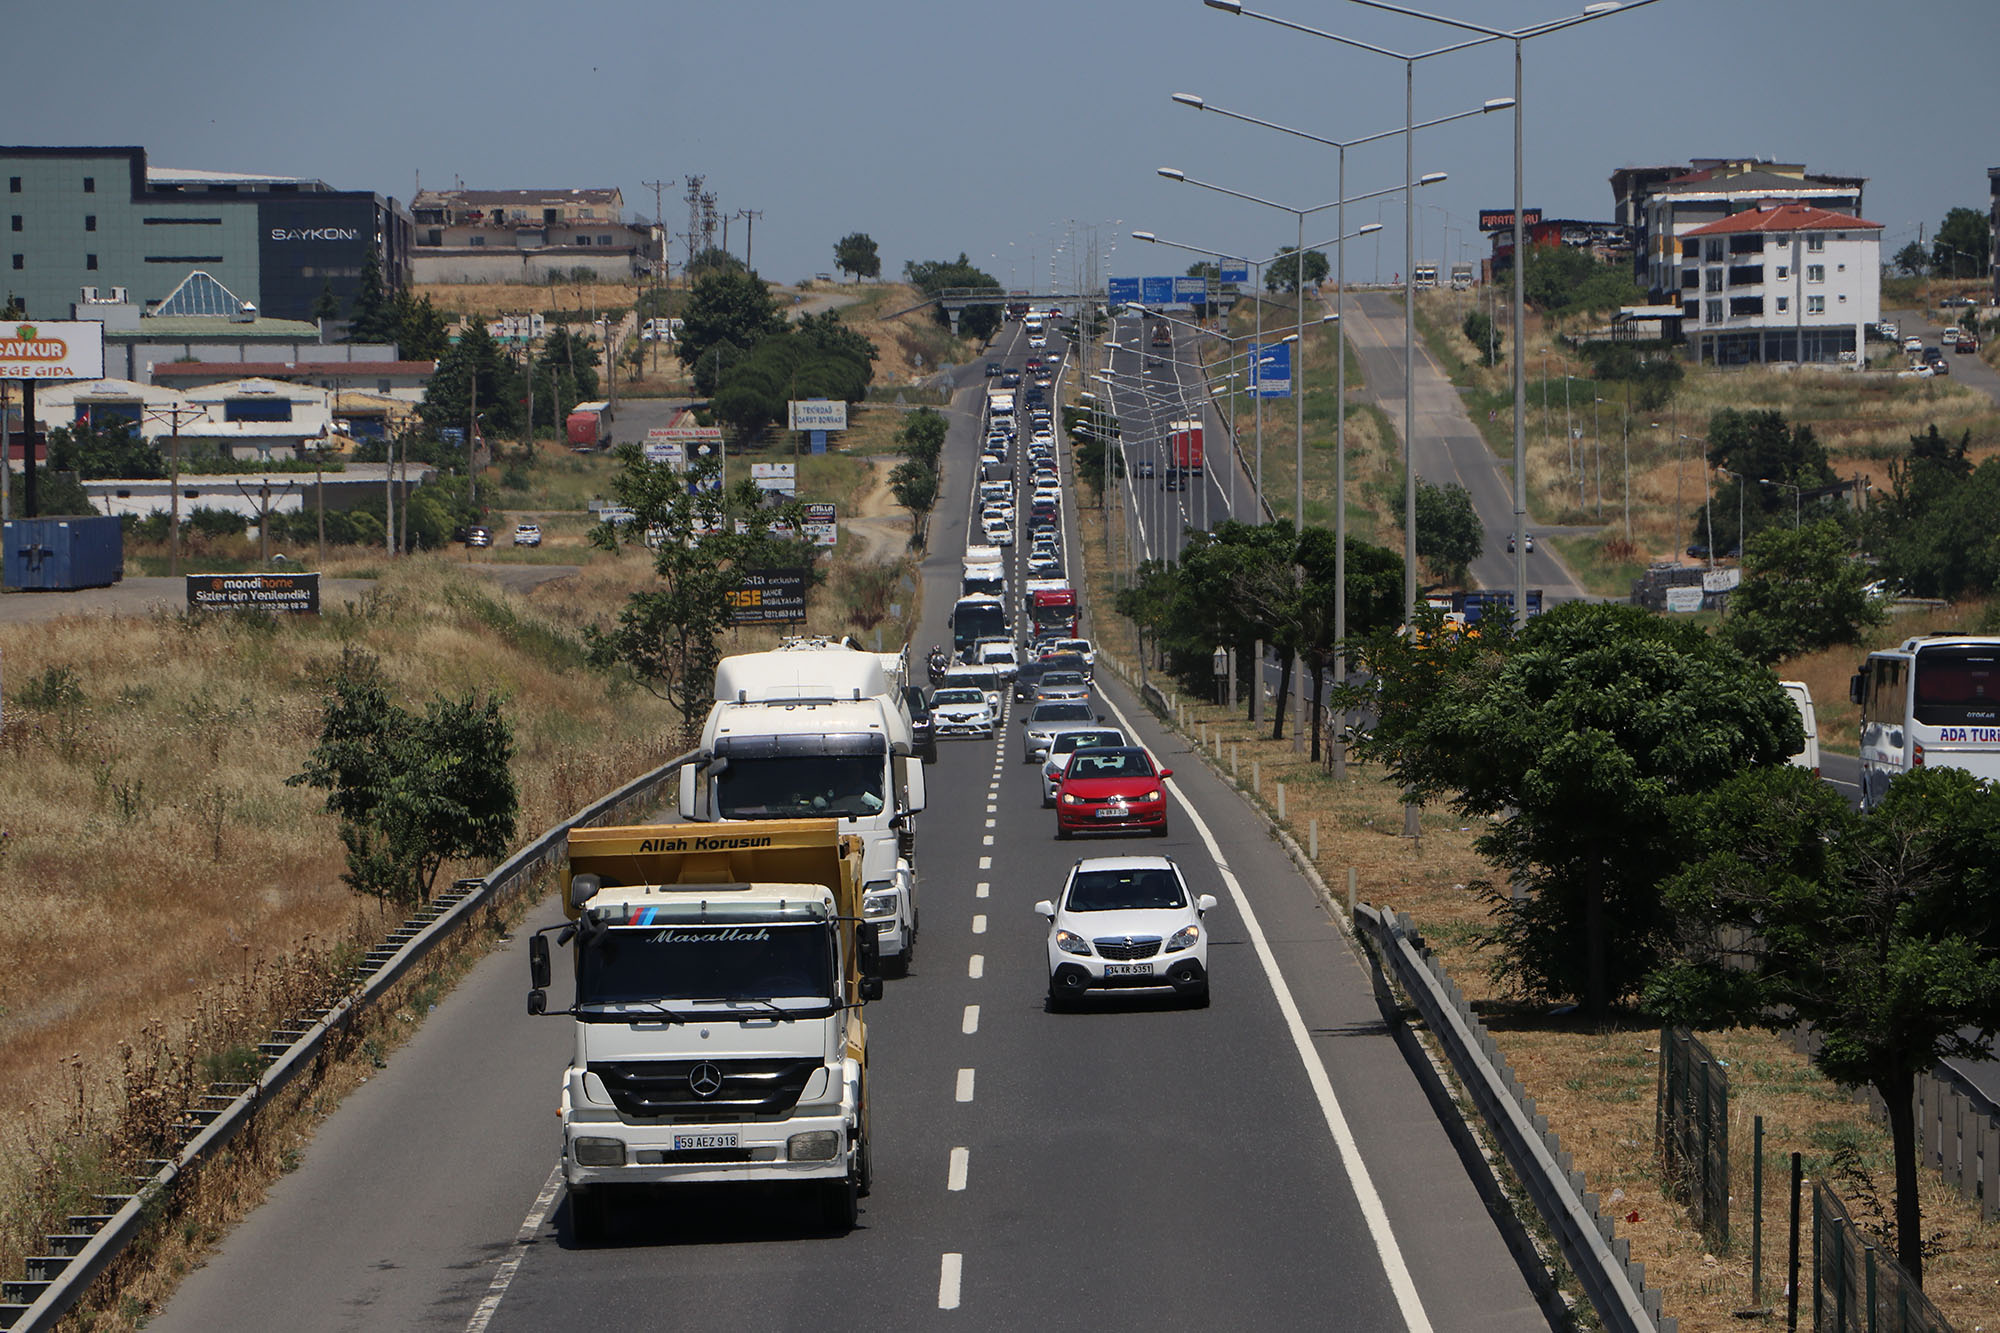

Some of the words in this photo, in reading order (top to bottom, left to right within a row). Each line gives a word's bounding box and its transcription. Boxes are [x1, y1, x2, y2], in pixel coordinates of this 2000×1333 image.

[271, 228, 353, 240] SAYKON
[196, 590, 227, 601] Sizler
[228, 590, 248, 602] için
[250, 589, 311, 601] Yenilendik!
[1940, 728, 1967, 742] ADA
[639, 838, 688, 852] Allah
[695, 836, 771, 850] Korusun
[681, 1137, 694, 1148] 59
[696, 1136, 715, 1148] AEZ
[717, 1136, 737, 1147] 918
